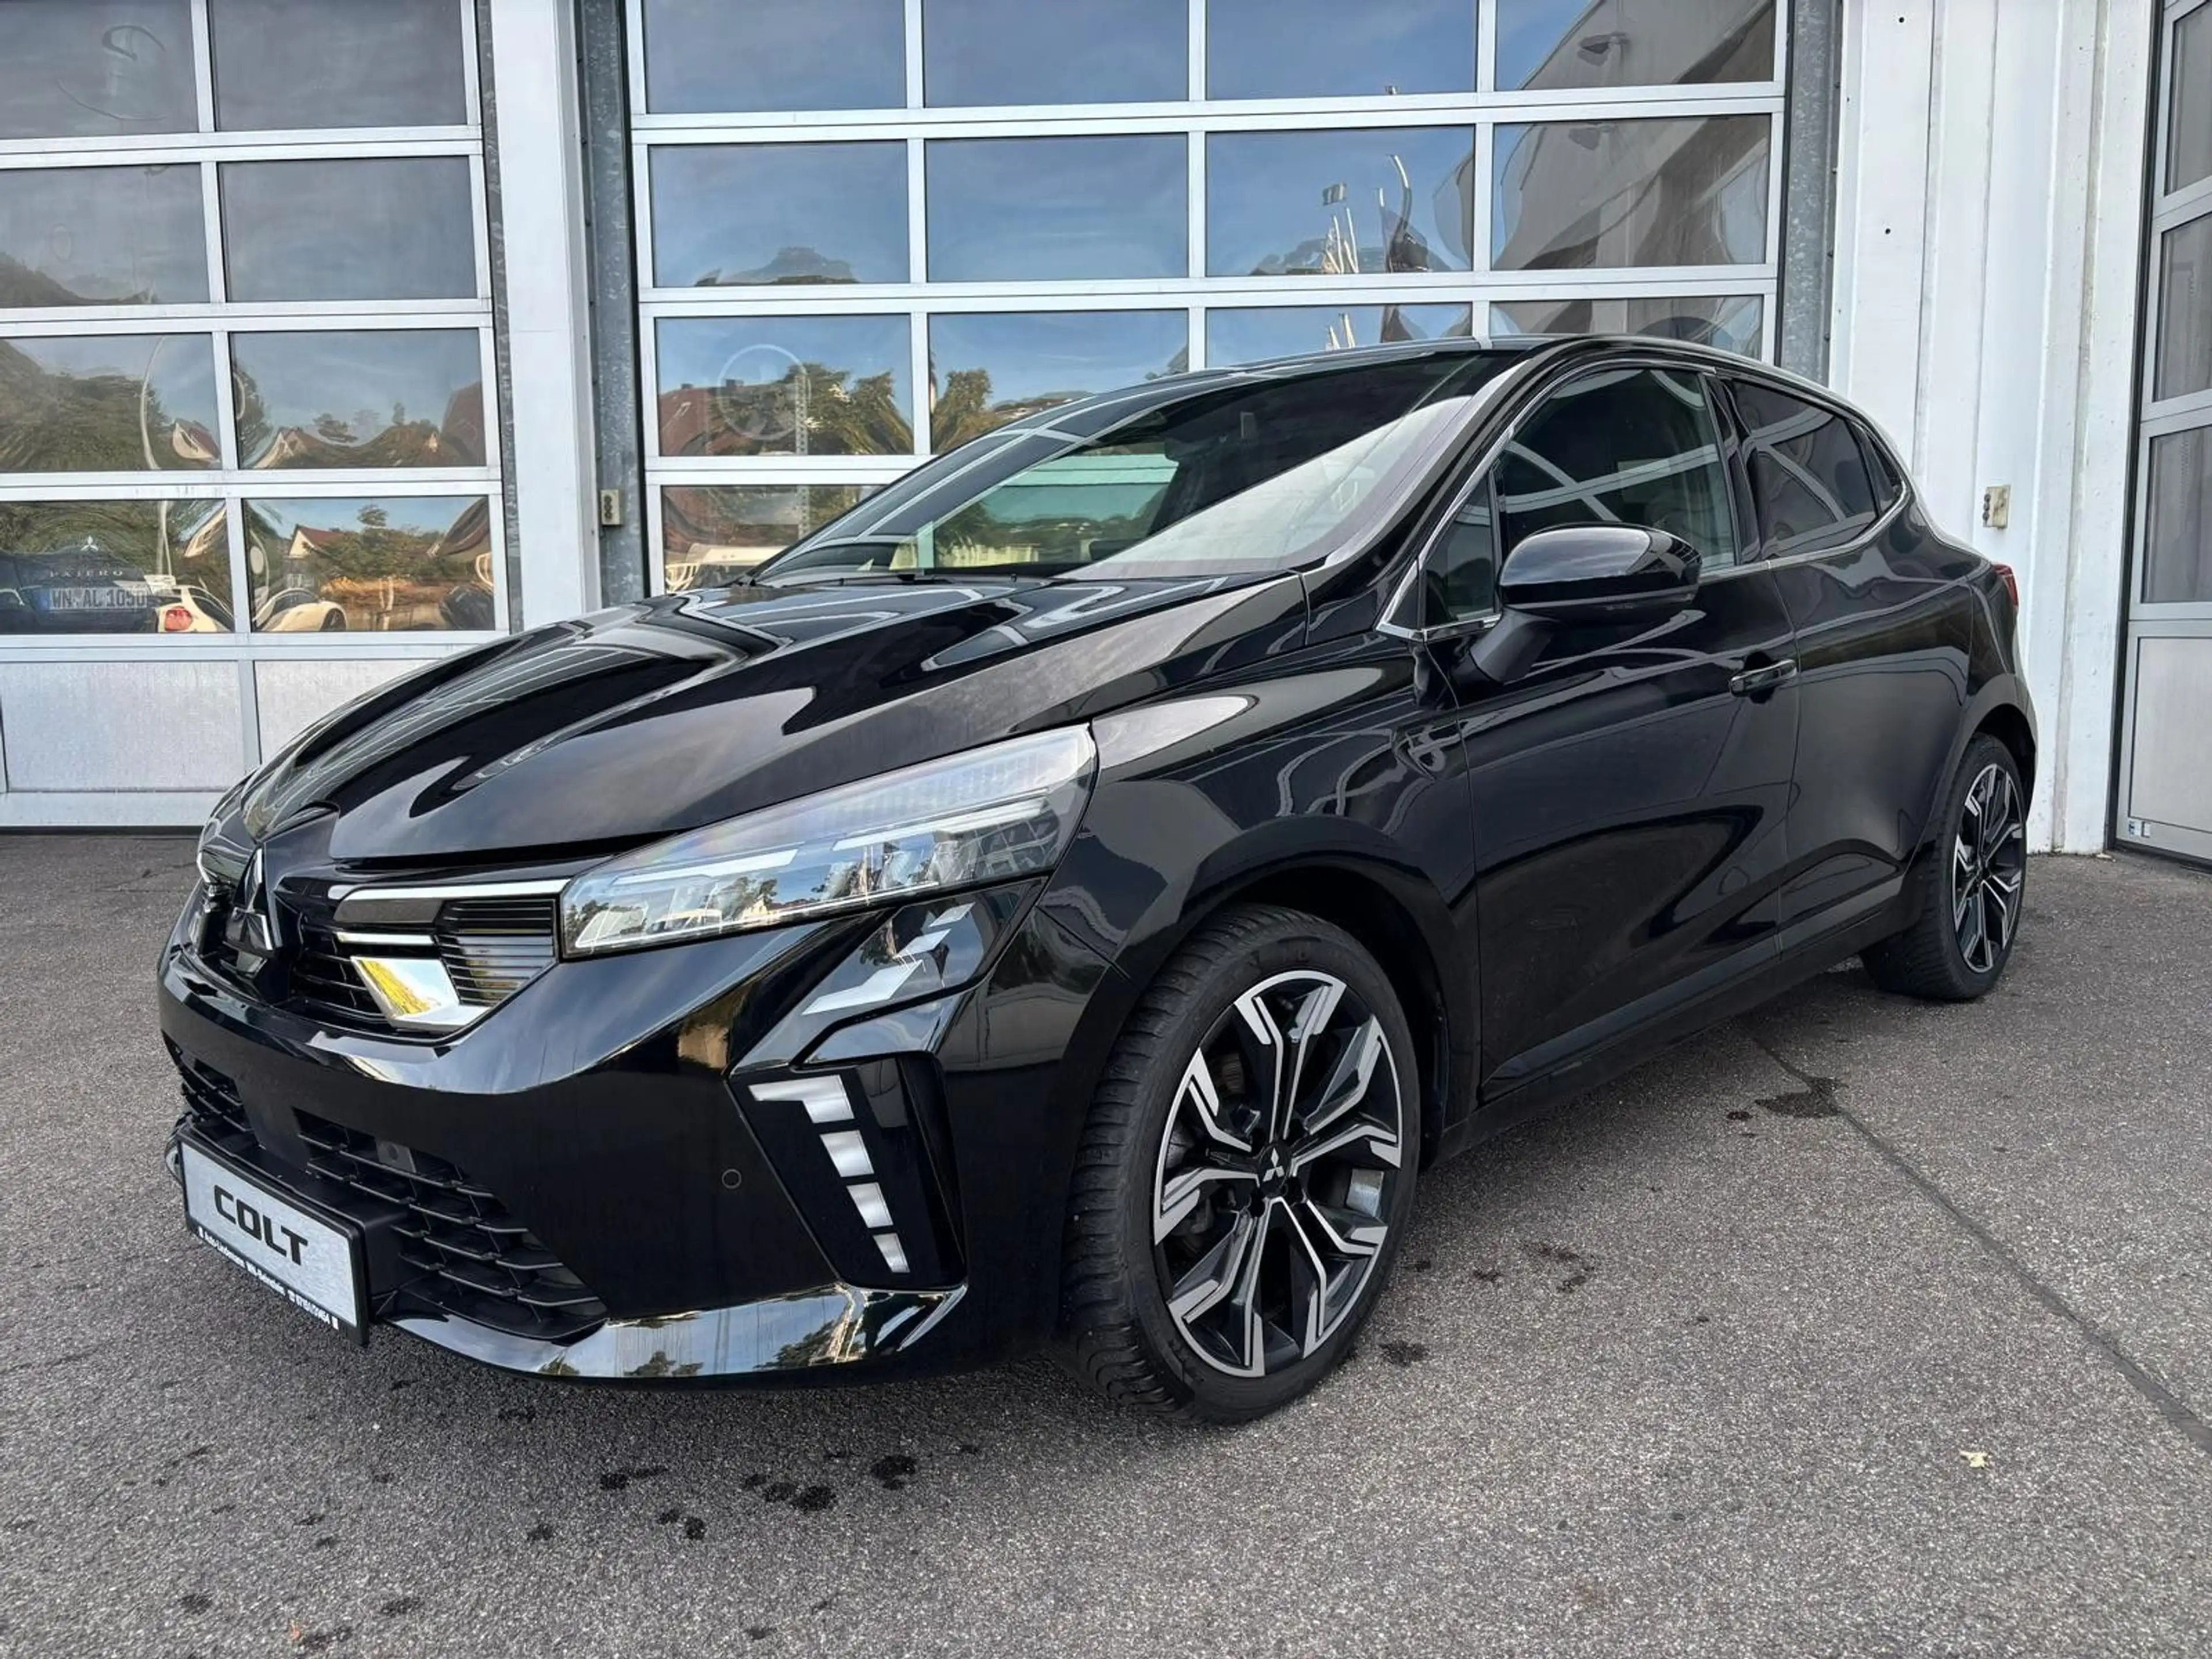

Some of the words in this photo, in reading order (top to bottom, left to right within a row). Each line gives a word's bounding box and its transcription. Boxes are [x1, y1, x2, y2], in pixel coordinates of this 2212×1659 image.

[52, 589, 72, 608] WN
[83, 589, 103, 607] AL
[214, 1184, 308, 1266] COLT
